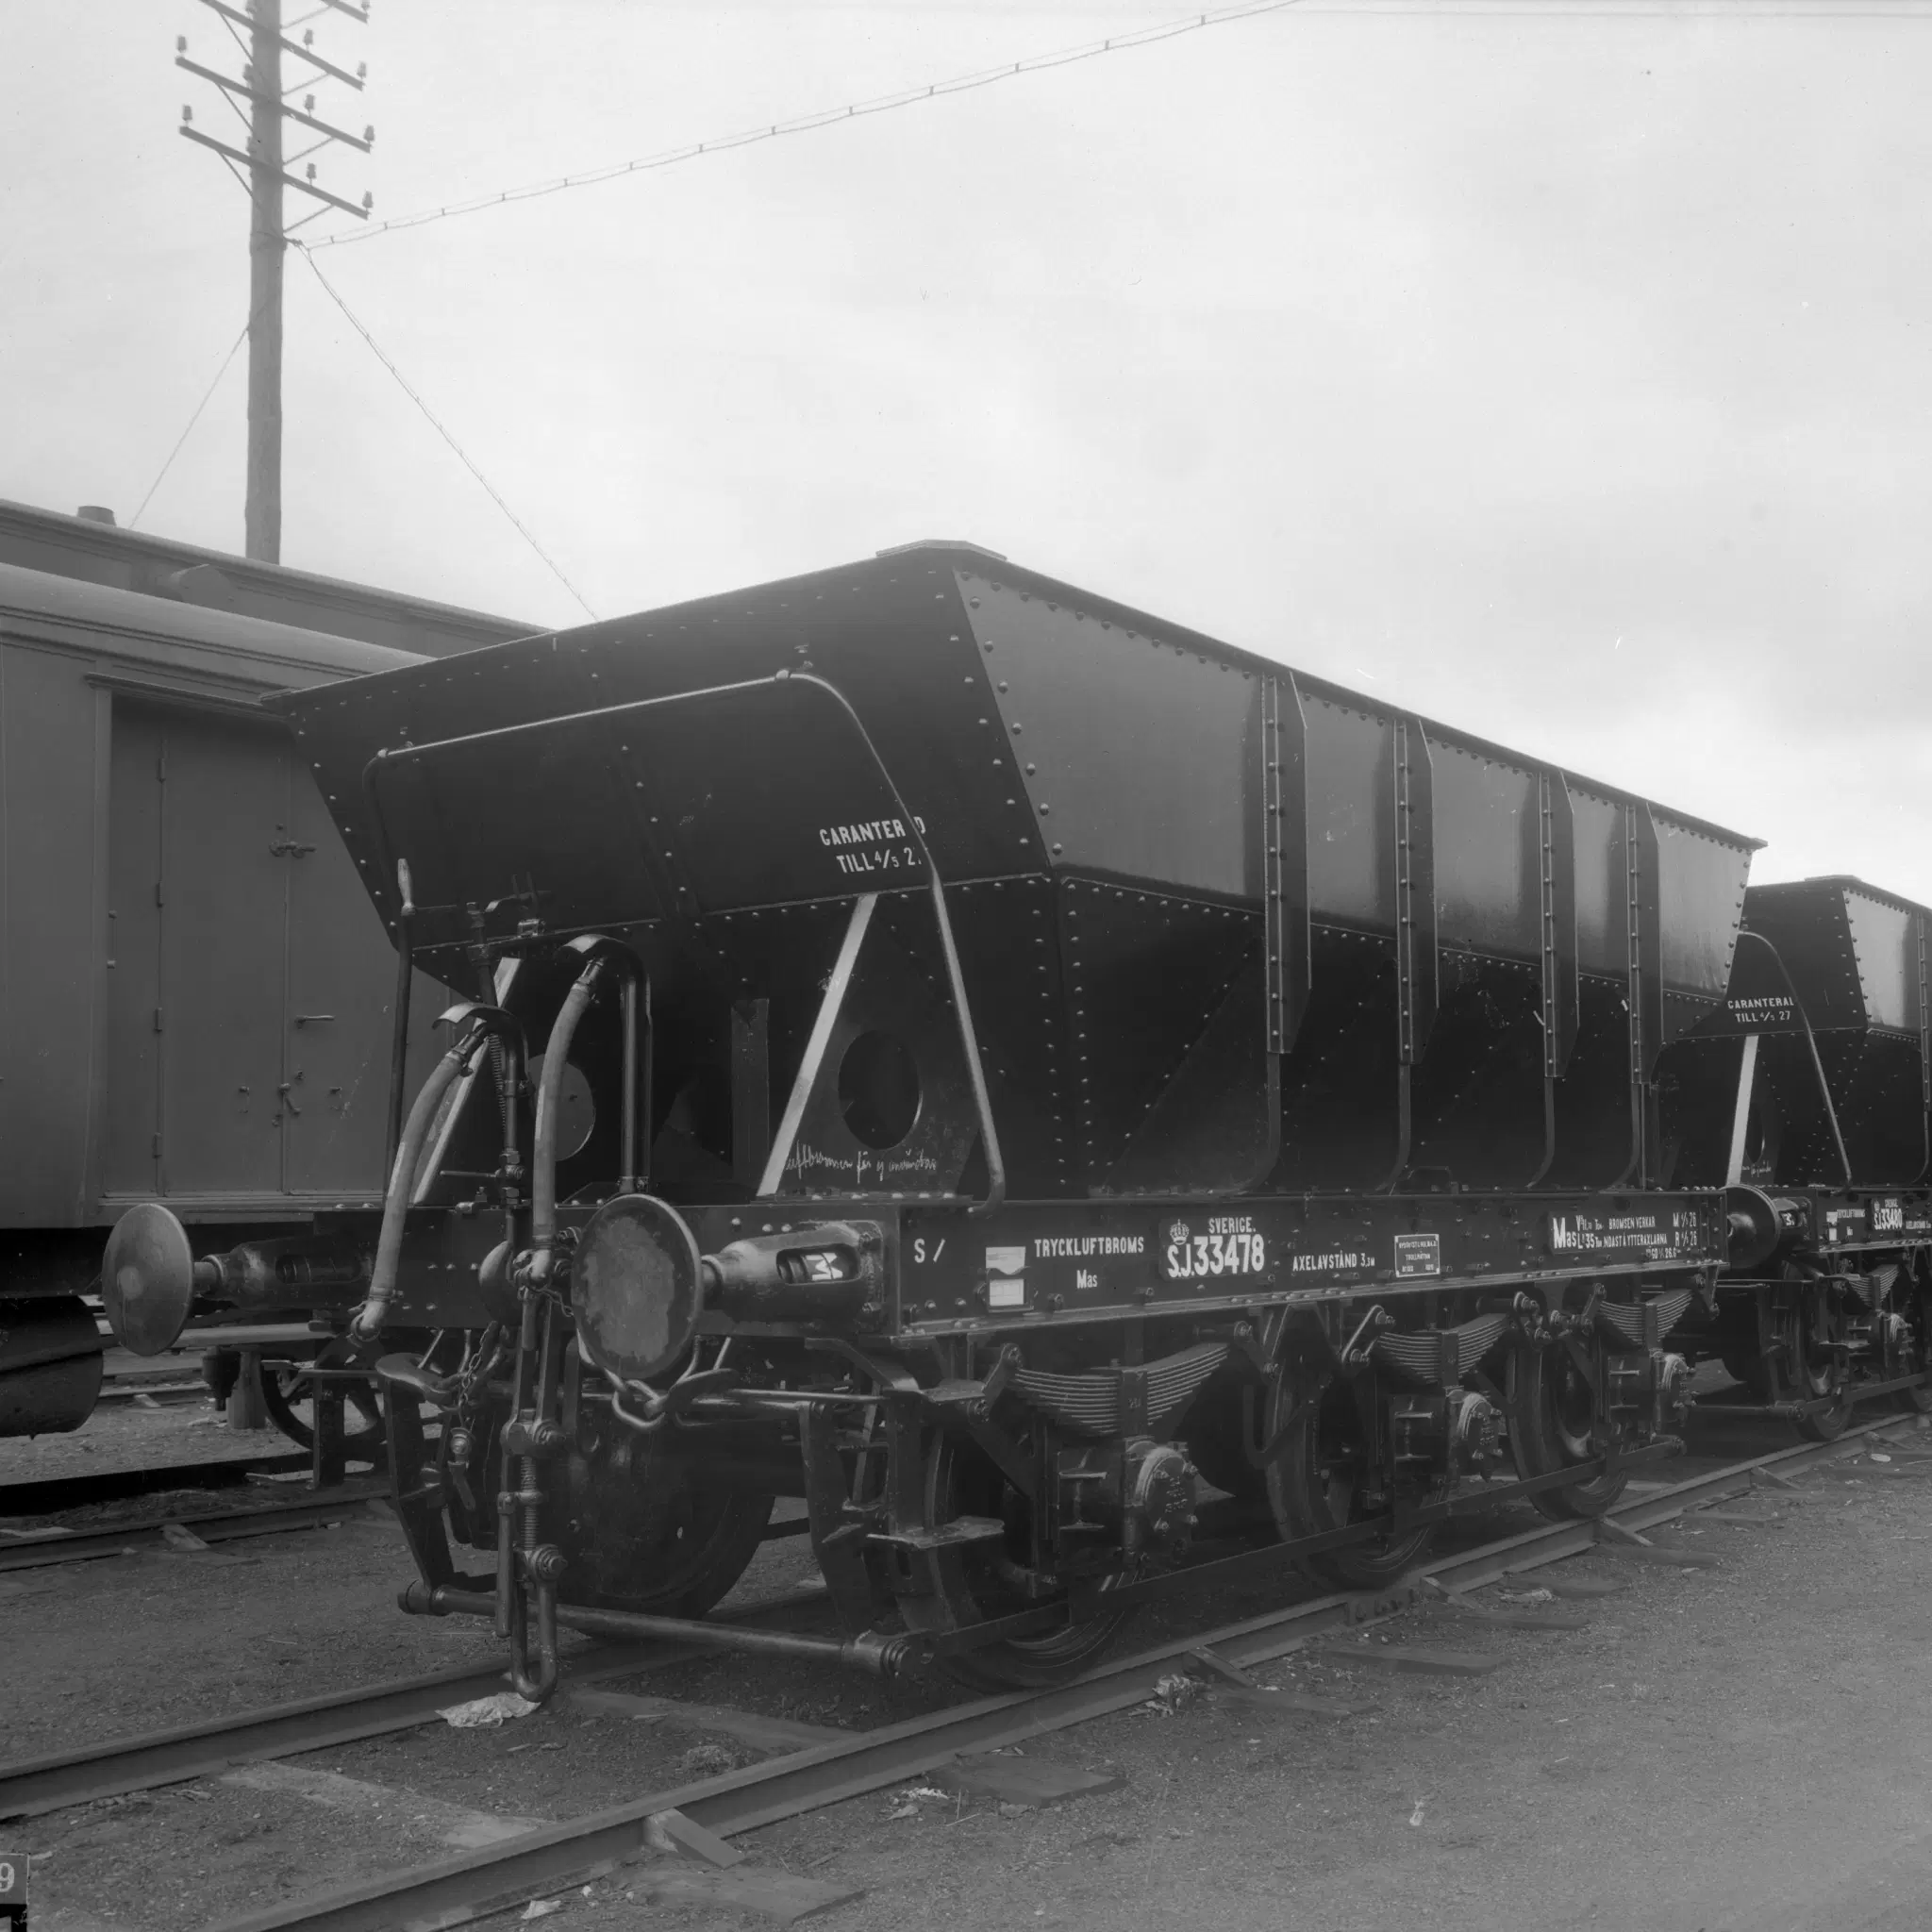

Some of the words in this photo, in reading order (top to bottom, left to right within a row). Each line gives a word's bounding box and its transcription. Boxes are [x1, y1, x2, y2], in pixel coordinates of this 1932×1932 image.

[819, 816, 926, 846] GARANTERD
[836, 852, 874, 874] TILL
[903, 846, 922, 866] 2
[1735, 1012, 1758, 1023] TILL
[1778, 1010, 1790, 1021] 27
[1608, 1217, 1634, 1230] BROMSEN
[1636, 1215, 1656, 1228] VERKAR
[1673, 1211, 1679, 1227] M
[1553, 1217, 1576, 1249] Mas
[1627, 1233, 1667, 1246] YTTERAXLARNA
[1034, 1236, 1144, 1257] TRYCKLUFTBROMS
[1292, 1249, 1357, 1272] AXELAVSTÅND
[1076, 1269, 1098, 1290] Mas
